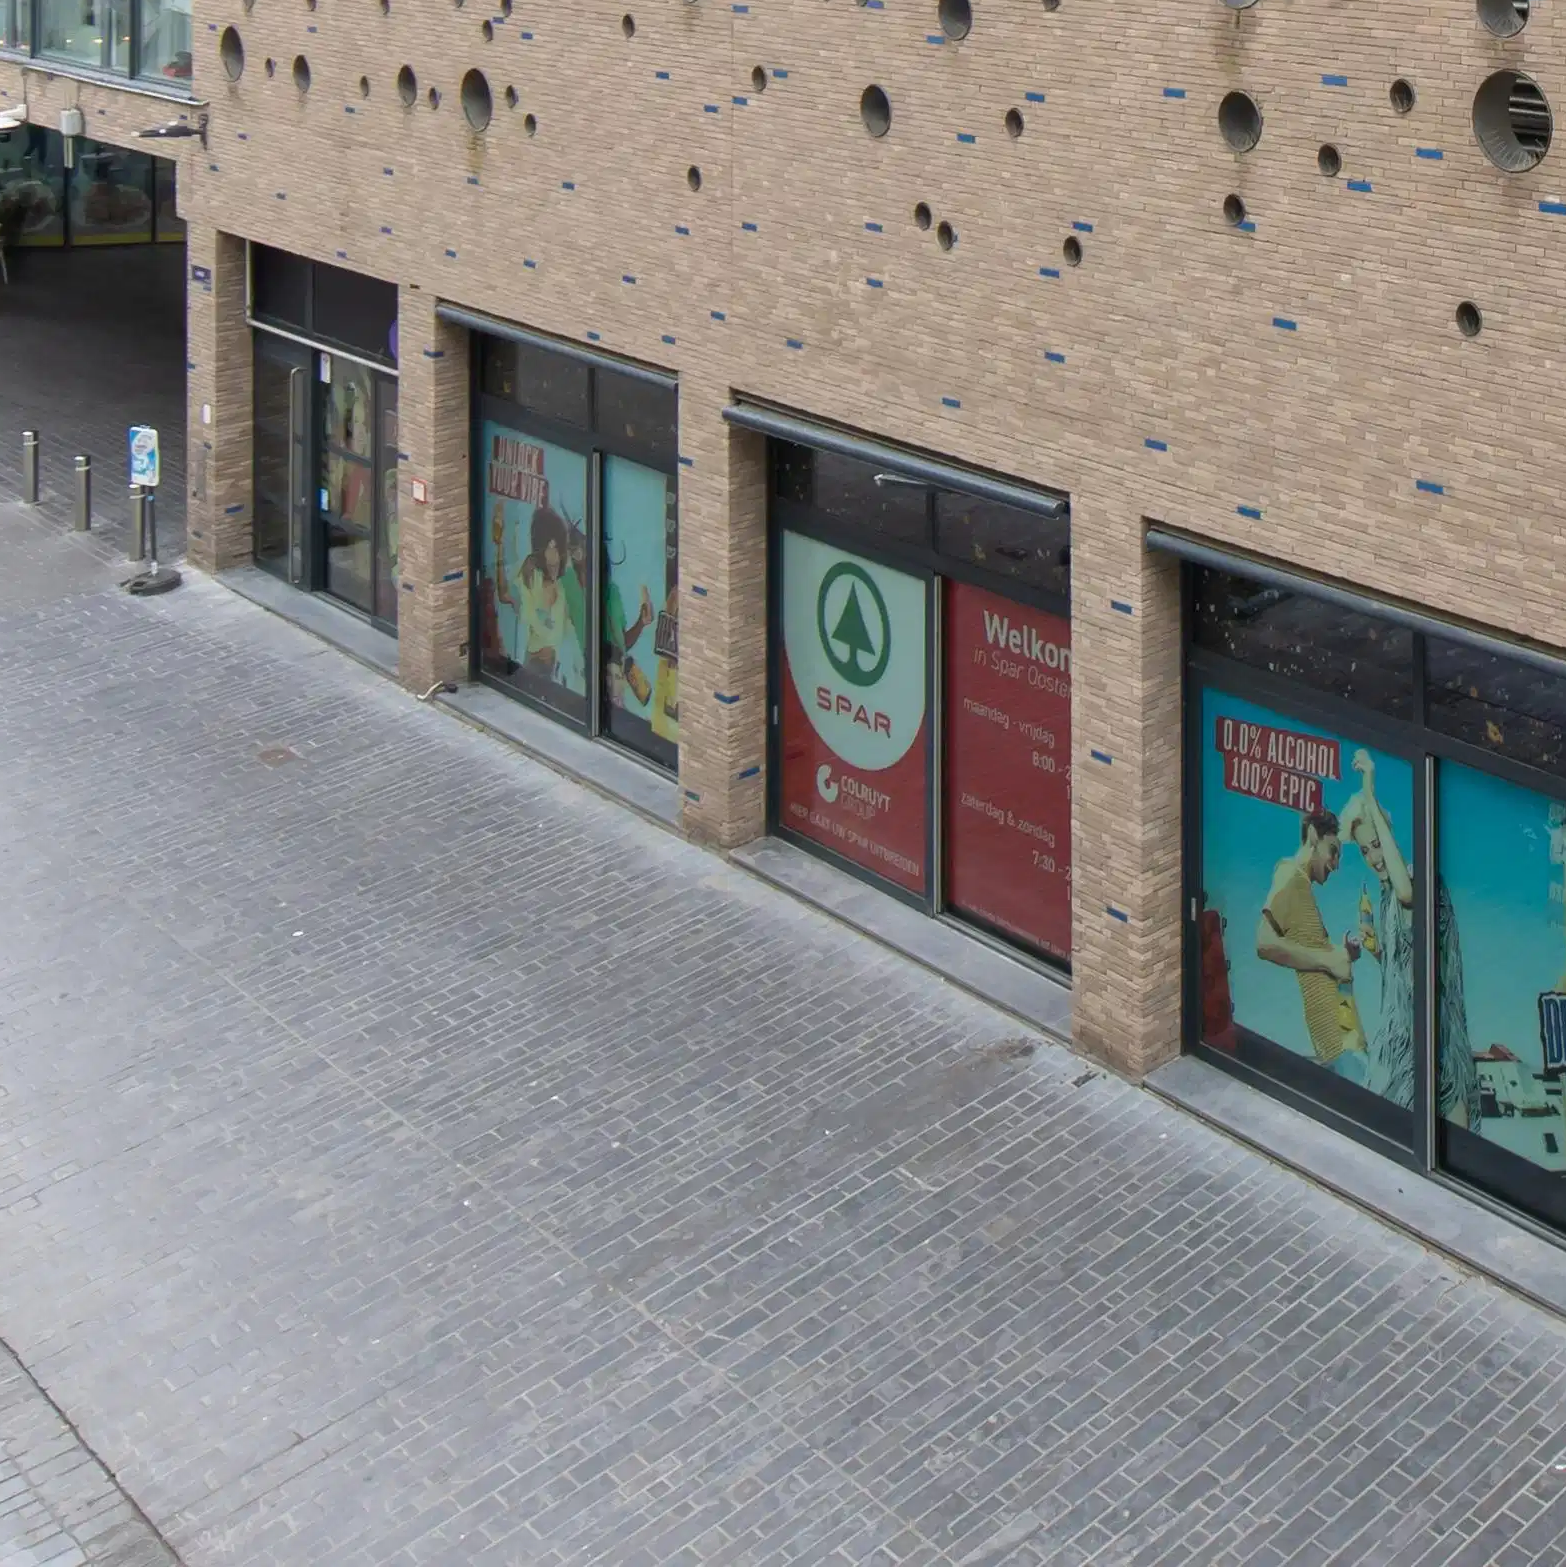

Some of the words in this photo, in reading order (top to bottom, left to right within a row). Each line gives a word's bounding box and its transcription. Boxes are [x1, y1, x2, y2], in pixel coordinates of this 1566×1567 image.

[972, 647, 987, 667] in
[991, 650, 1025, 680] Spar
[817, 686, 891, 739] SPAR
[963, 697, 1010, 730] maandag
[1019, 719, 1055, 749] vrijdag
[1032, 751, 1056, 773] 8:00
[1223, 719, 1262, 759] 0.0%
[1267, 731, 1337, 780] ALCOHOL
[841, 775, 891, 813] COLRUYT
[1231, 757, 1274, 800] 100%
[1279, 771, 1316, 813] EPIC
[961, 792, 1005, 825] zaterdag
[1006, 810, 1016, 828] &
[1017, 819, 1056, 849] zondag
[1032, 848, 1056, 874] 7:30
